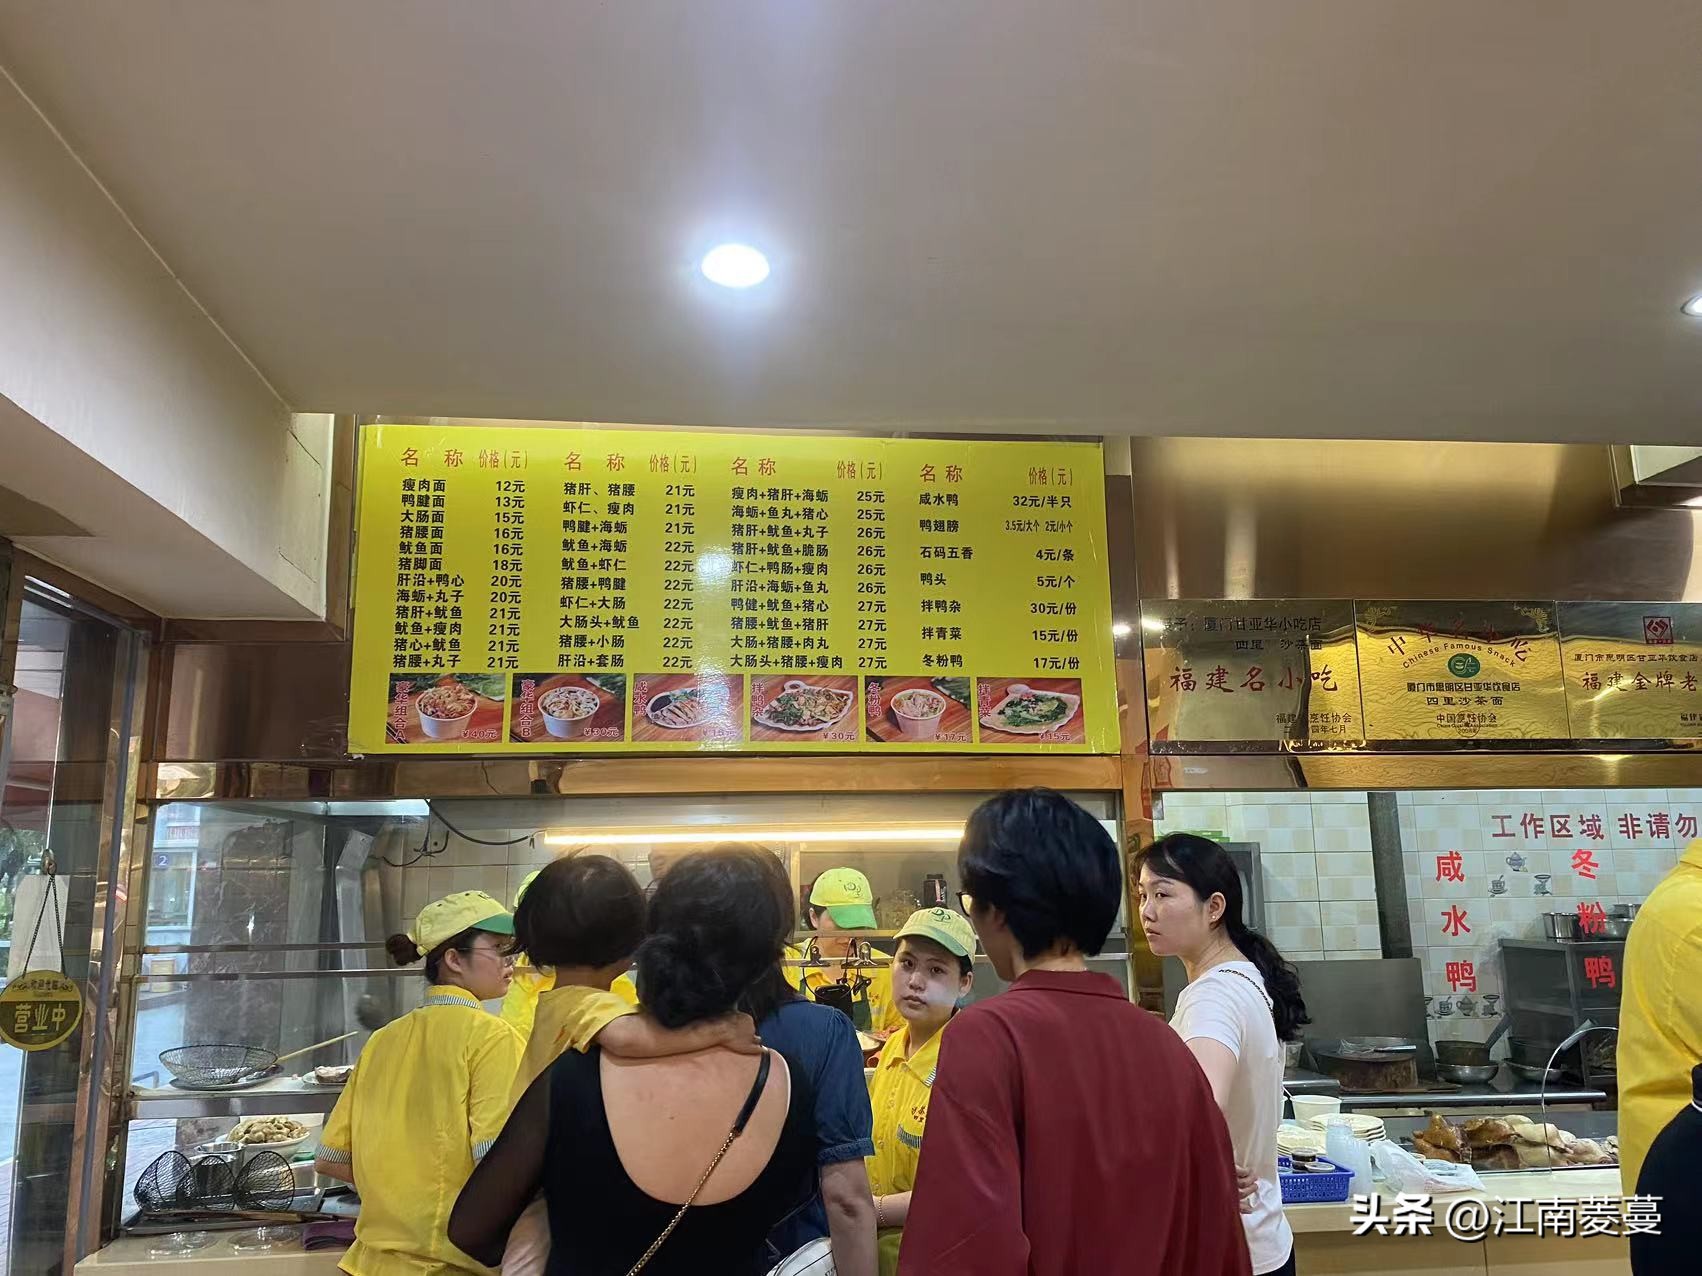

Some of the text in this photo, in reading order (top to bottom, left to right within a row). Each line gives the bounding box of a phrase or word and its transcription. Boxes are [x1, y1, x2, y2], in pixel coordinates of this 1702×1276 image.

[403, 479, 525, 493] 瘦肉面 12元
[666, 484, 695, 497] 21元
[495, 496, 525, 508] 13元
[732, 487, 885, 503] 瘦肉+猪肝+海蛎 25元
[919, 493, 1072, 508] 咸水鸭 32元/半只
[401, 510, 524, 524] 大肠面 15元
[665, 503, 695, 516] 21元
[732, 505, 885, 521] 海蛎+鱼丸+猪心 25元
[400, 526, 524, 540] 猪腰面 16元
[665, 522, 694, 535] 21元
[732, 523, 885, 539] 猪肝+鱿鱼+丸子 26元
[919, 519, 1072, 533] 鸭翅膀 3.5元/大个 2元/小个
[399, 542, 523, 555] 鱿鱼面 16元
[562, 539, 694, 553] 鱿鱼+海蛎 22元
[732, 542, 885, 558] 猪肝+鱿鱼+脆肠 26元
[920, 546, 1074, 561] 石码五香 4元/条
[398, 557, 522, 571] 猪脚面 18元
[561, 557, 694, 573] 鱿鱼+虾仁 22元
[732, 562, 886, 576] 虾仁+鸭肠+瘦肉 26元
[396, 574, 521, 588] 肝沿+鸭心 20元
[664, 579, 694, 592] 22元
[730, 579, 886, 595] 肝沿+海蛎+鱼丸 26元
[921, 572, 1075, 588] 鸭头 5元/个
[396, 590, 521, 604] 海蛎+丸子 20元
[560, 596, 693, 611] 虾仁+大肠 22元
[396, 606, 520, 620] 猪肝+鱿鱼 21元
[858, 601, 886, 613] 27元
[921, 599, 1076, 615] 拌鸭杂 30元/份
[395, 622, 520, 636] 鱿鱼+瘦肉 21元
[560, 616, 693, 630] 大肠头+鱿鱼 22元
[730, 617, 886, 632] 猪腰+鱿鱼+猪肝 27元
[559, 634, 693, 649] 猪腰+小肠 22元
[922, 626, 1078, 643] 拌青菜 15元/份
[394, 638, 519, 652] 猪心+鱿鱼 21元
[730, 635, 887, 650] 大肠+猪腰+肉丸 27元
[393, 654, 518, 669] 猪腰+丸子 21元
[558, 654, 692, 668] 肝沿+套肠 22元
[730, 654, 887, 669] 大肠头+猪腰+瘦肉 27元
[922, 653, 1079, 670] 冬粉鸭 17元/份
[1403, 643, 1516, 668] Chinese Famous Snack
[1170, 665, 1338, 692] 福建名小吃
[634, 680, 647, 715] 咸水鸭
[752, 682, 765, 716] 拌鸭杂
[868, 682, 881, 717] 冬粉鸭
[978, 683, 991, 718] 拌青菜
[1427, 697, 1503, 705] 四里沙茶面
[1492, 813, 1698, 839] 工作区域 非请勿
[160, 855, 167, 865] 2
[1435, 851, 1477, 992] 咸水鸭
[1572, 849, 1616, 989] 冬粉鸭
[14, 1003, 66, 1033] 营业中
